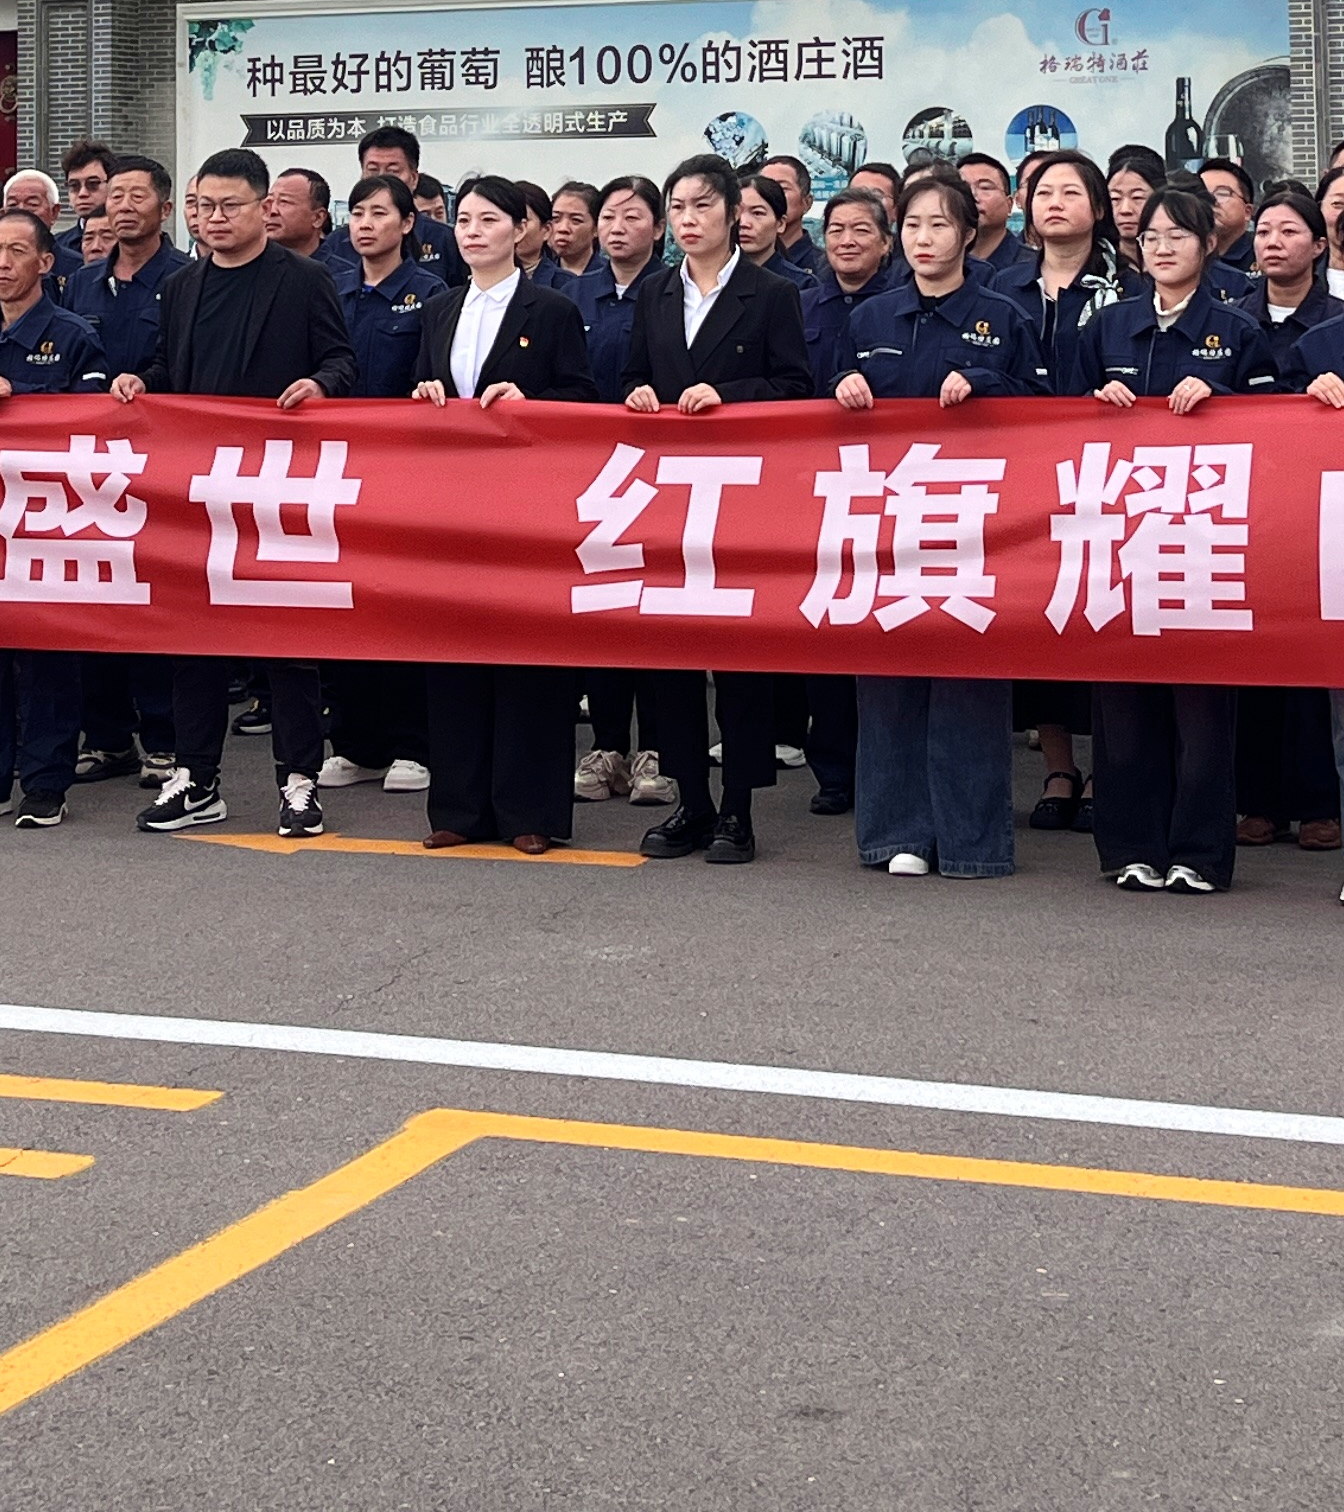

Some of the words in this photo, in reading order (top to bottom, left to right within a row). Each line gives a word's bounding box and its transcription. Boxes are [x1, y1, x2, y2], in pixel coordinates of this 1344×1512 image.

[246, 46, 500, 98] 种最好的葡萄
[525, 35, 885, 90] 酿100%的酒庄酒
[265, 117, 367, 141] 以品质为本
[376, 109, 629, 137] 打造食品行业全透明式生产
